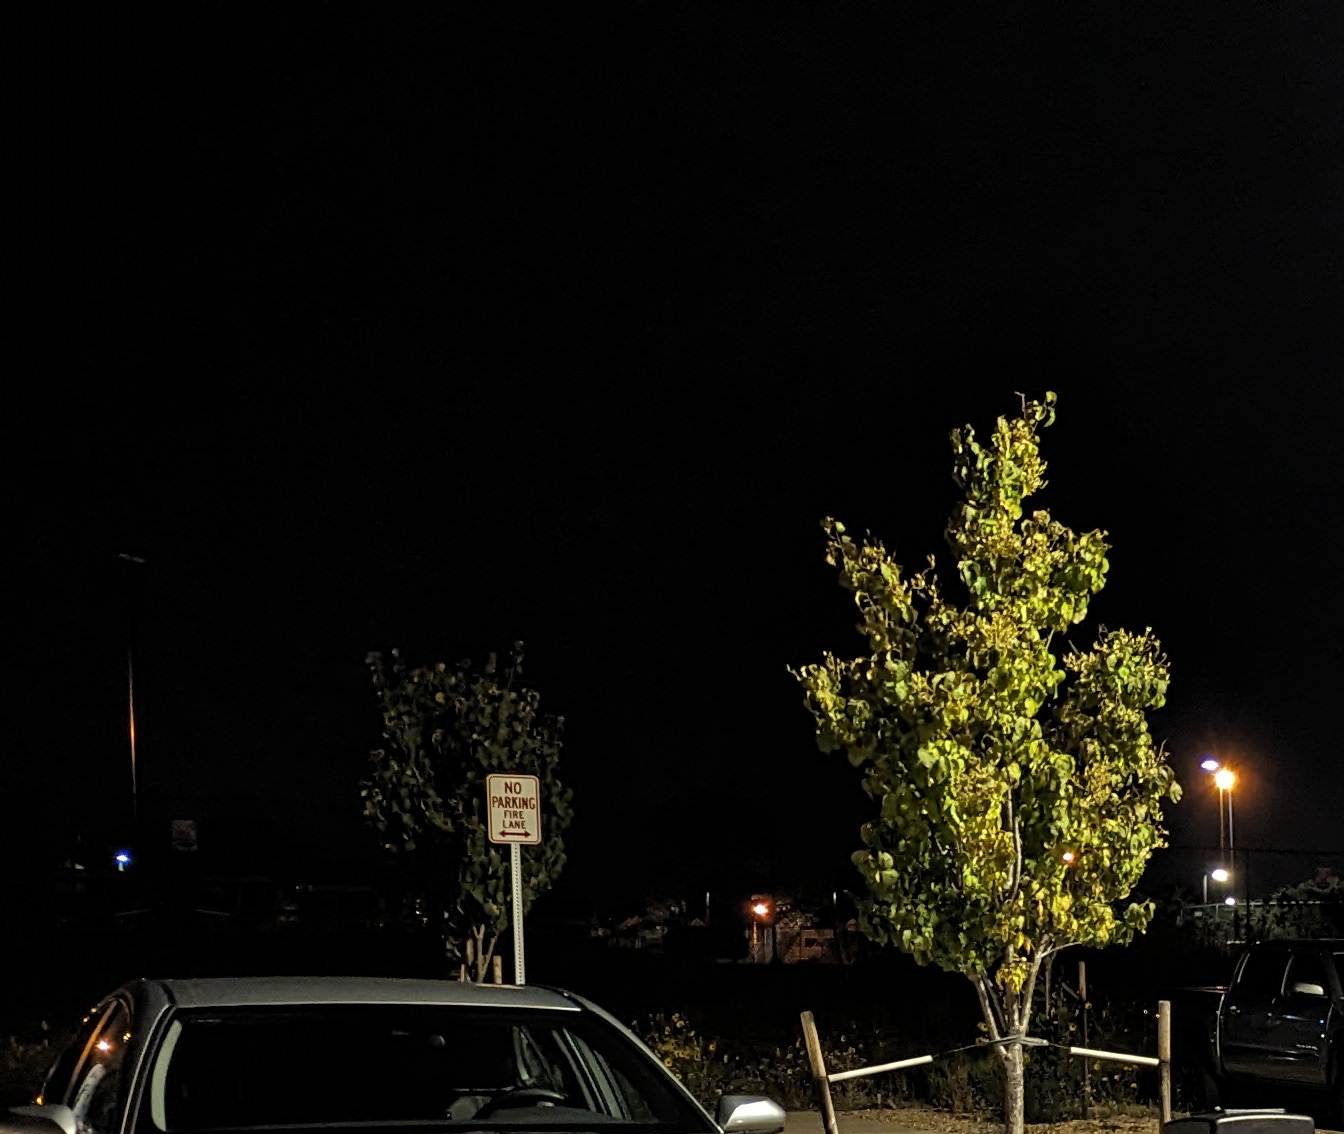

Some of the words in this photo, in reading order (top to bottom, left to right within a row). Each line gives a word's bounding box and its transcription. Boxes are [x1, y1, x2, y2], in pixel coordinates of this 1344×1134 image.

[504, 781, 522, 794] NO
[492, 796, 536, 810] PARKING
[504, 810, 525, 819] FIRE
[502, 820, 526, 829] LANE
